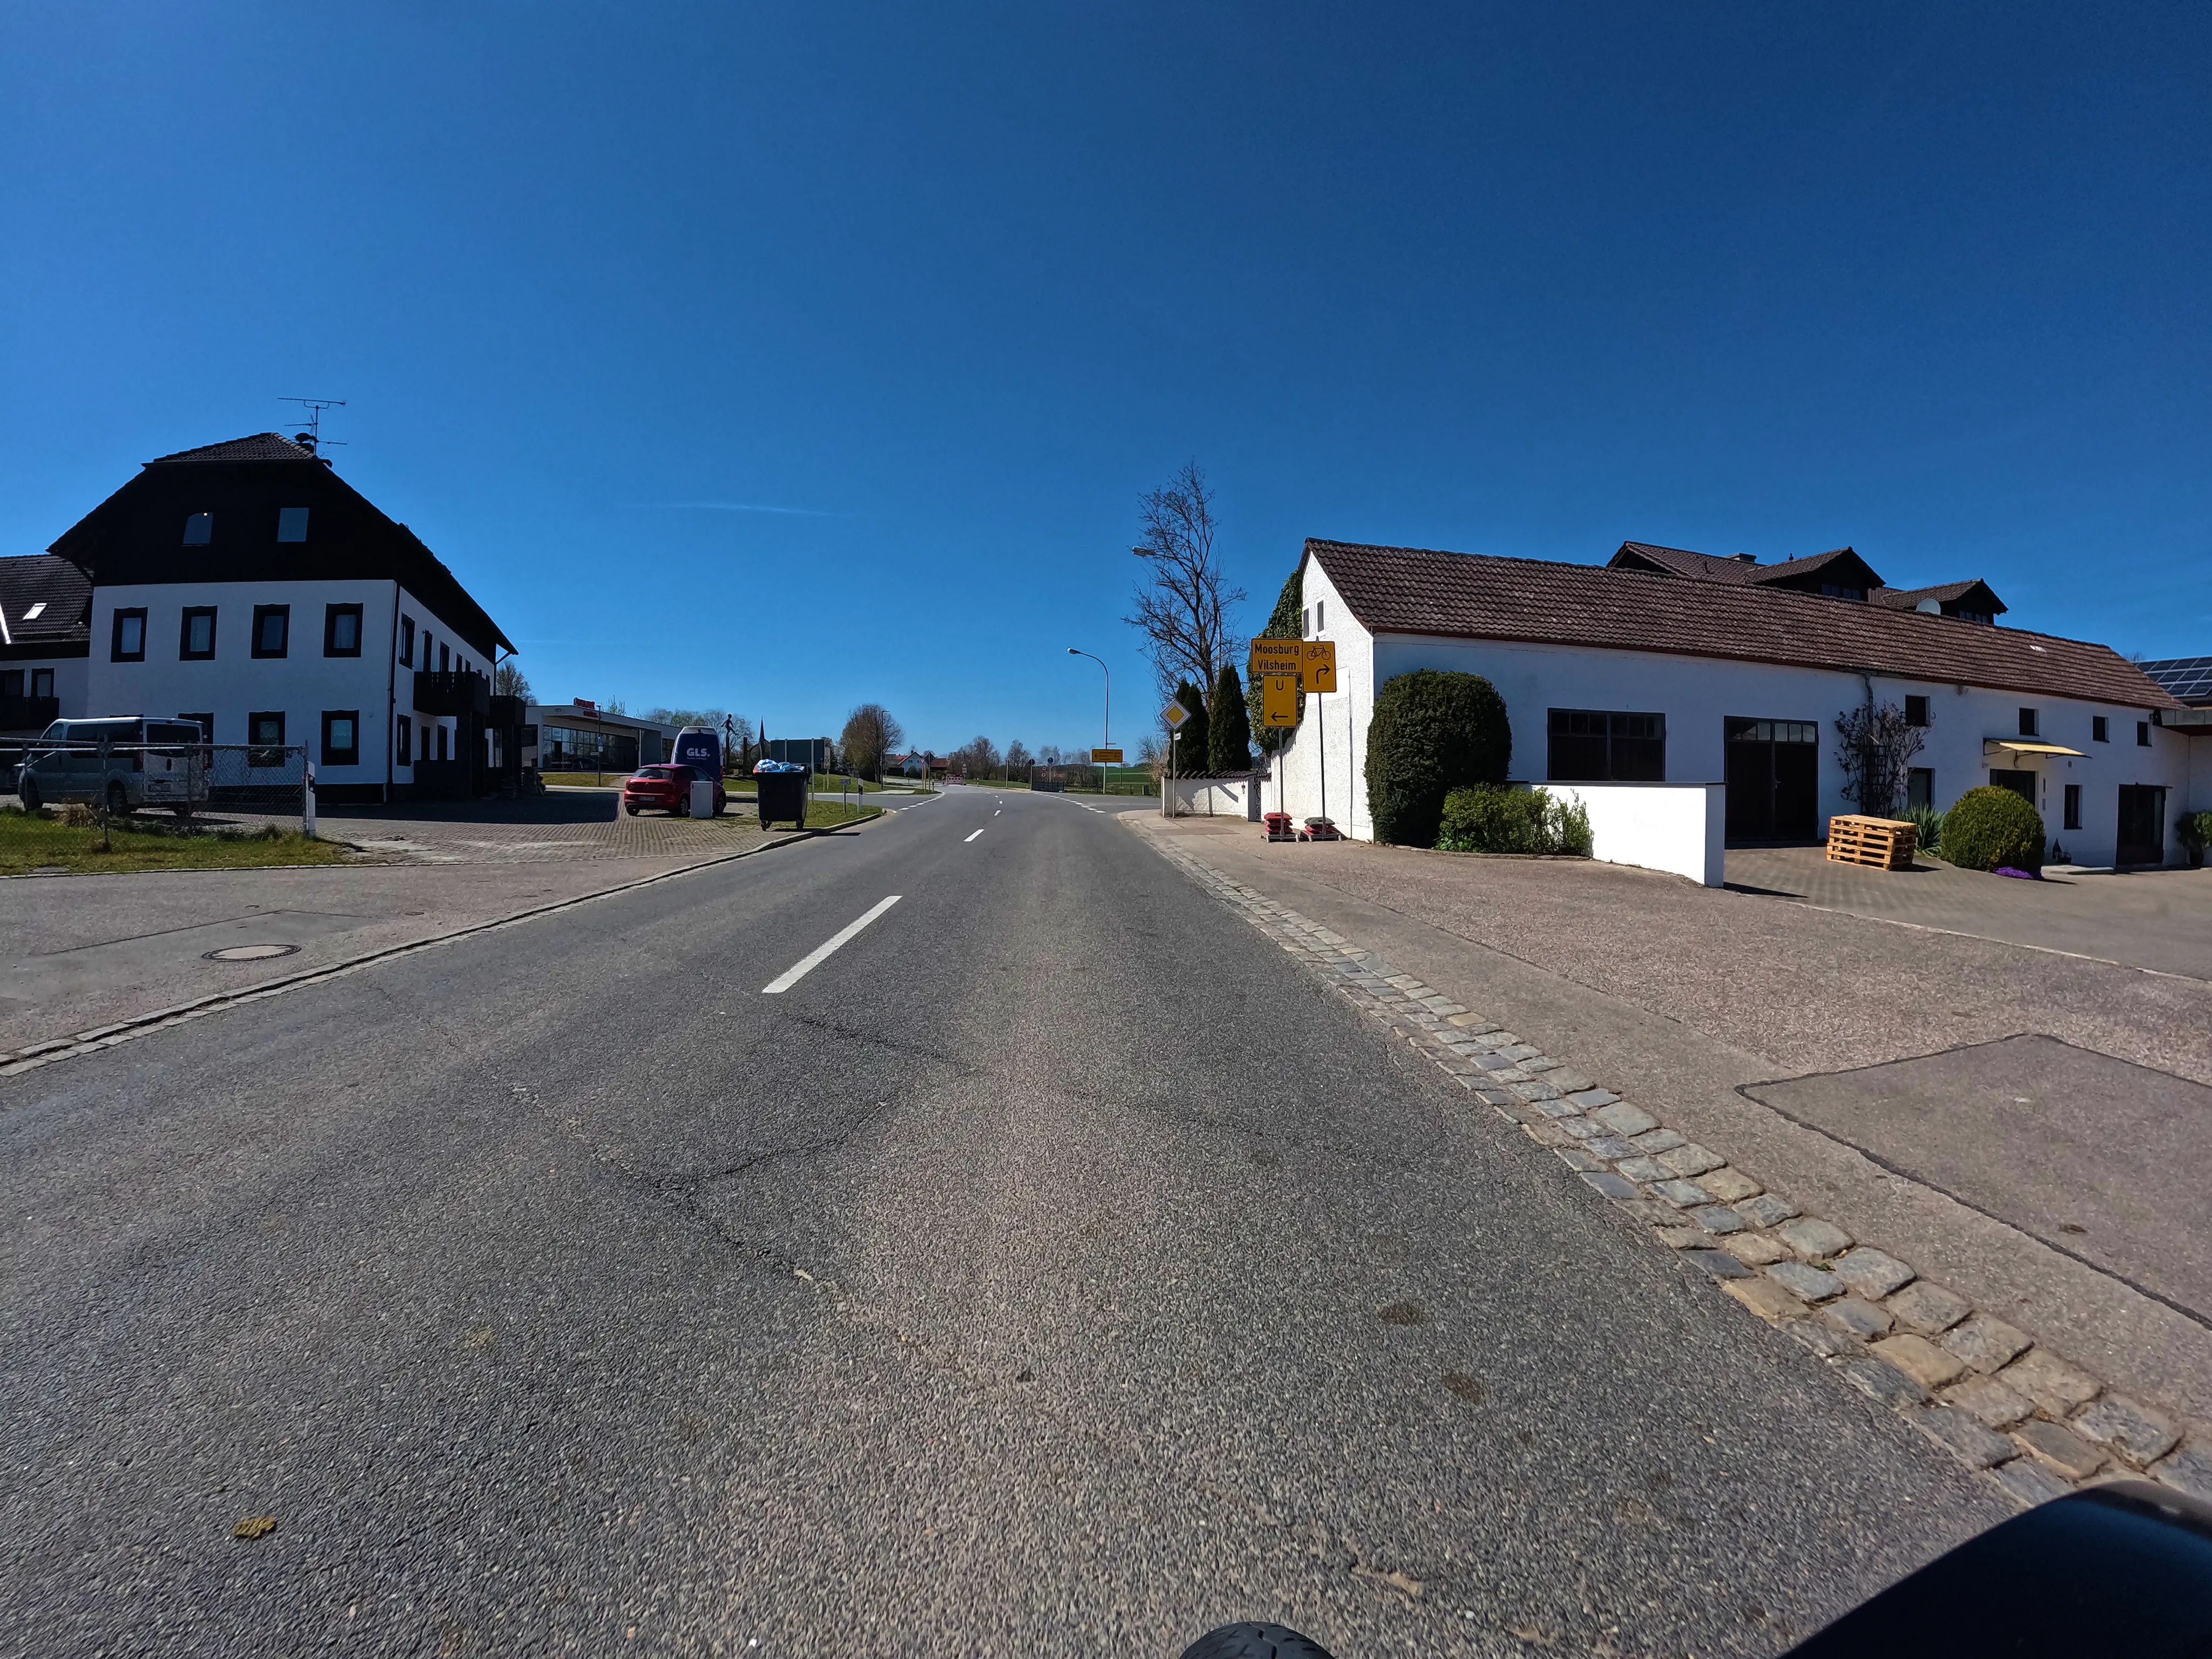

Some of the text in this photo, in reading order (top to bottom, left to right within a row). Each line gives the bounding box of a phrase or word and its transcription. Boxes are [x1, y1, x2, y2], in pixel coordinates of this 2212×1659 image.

[1255, 643, 1299, 656] Moosburg
[1258, 659, 1296, 670] Vilsheim
[1276, 679, 1284, 691] U
